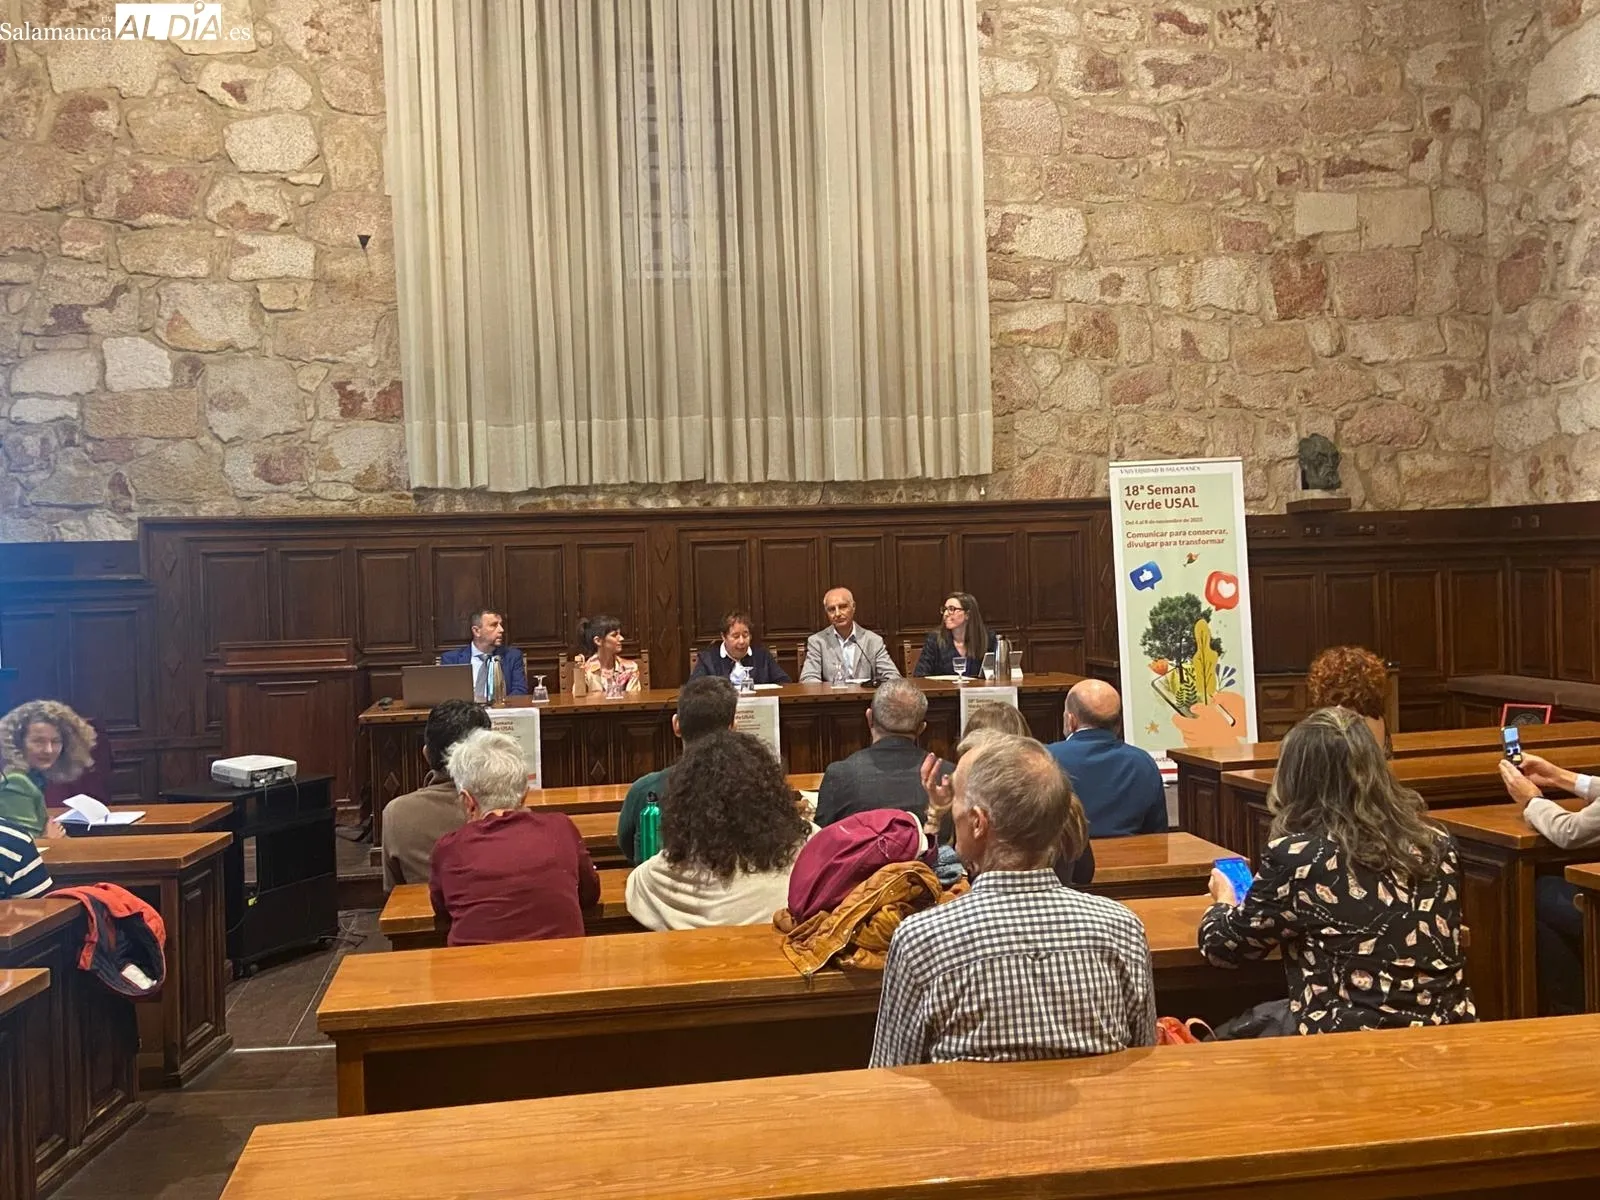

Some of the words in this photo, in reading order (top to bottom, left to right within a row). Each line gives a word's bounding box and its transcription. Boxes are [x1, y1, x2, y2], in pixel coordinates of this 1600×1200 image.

[1147, 484, 1196, 495] Semana
[1125, 499, 1162, 511] Verde
[1164, 497, 1199, 509] USAL
[1126, 531, 1168, 539] Comunicar
[1169, 530, 1187, 538] para
[1127, 540, 1158, 549] divulgar
[1160, 540, 1179, 548] para
[1179, 538, 1225, 546] transformar
